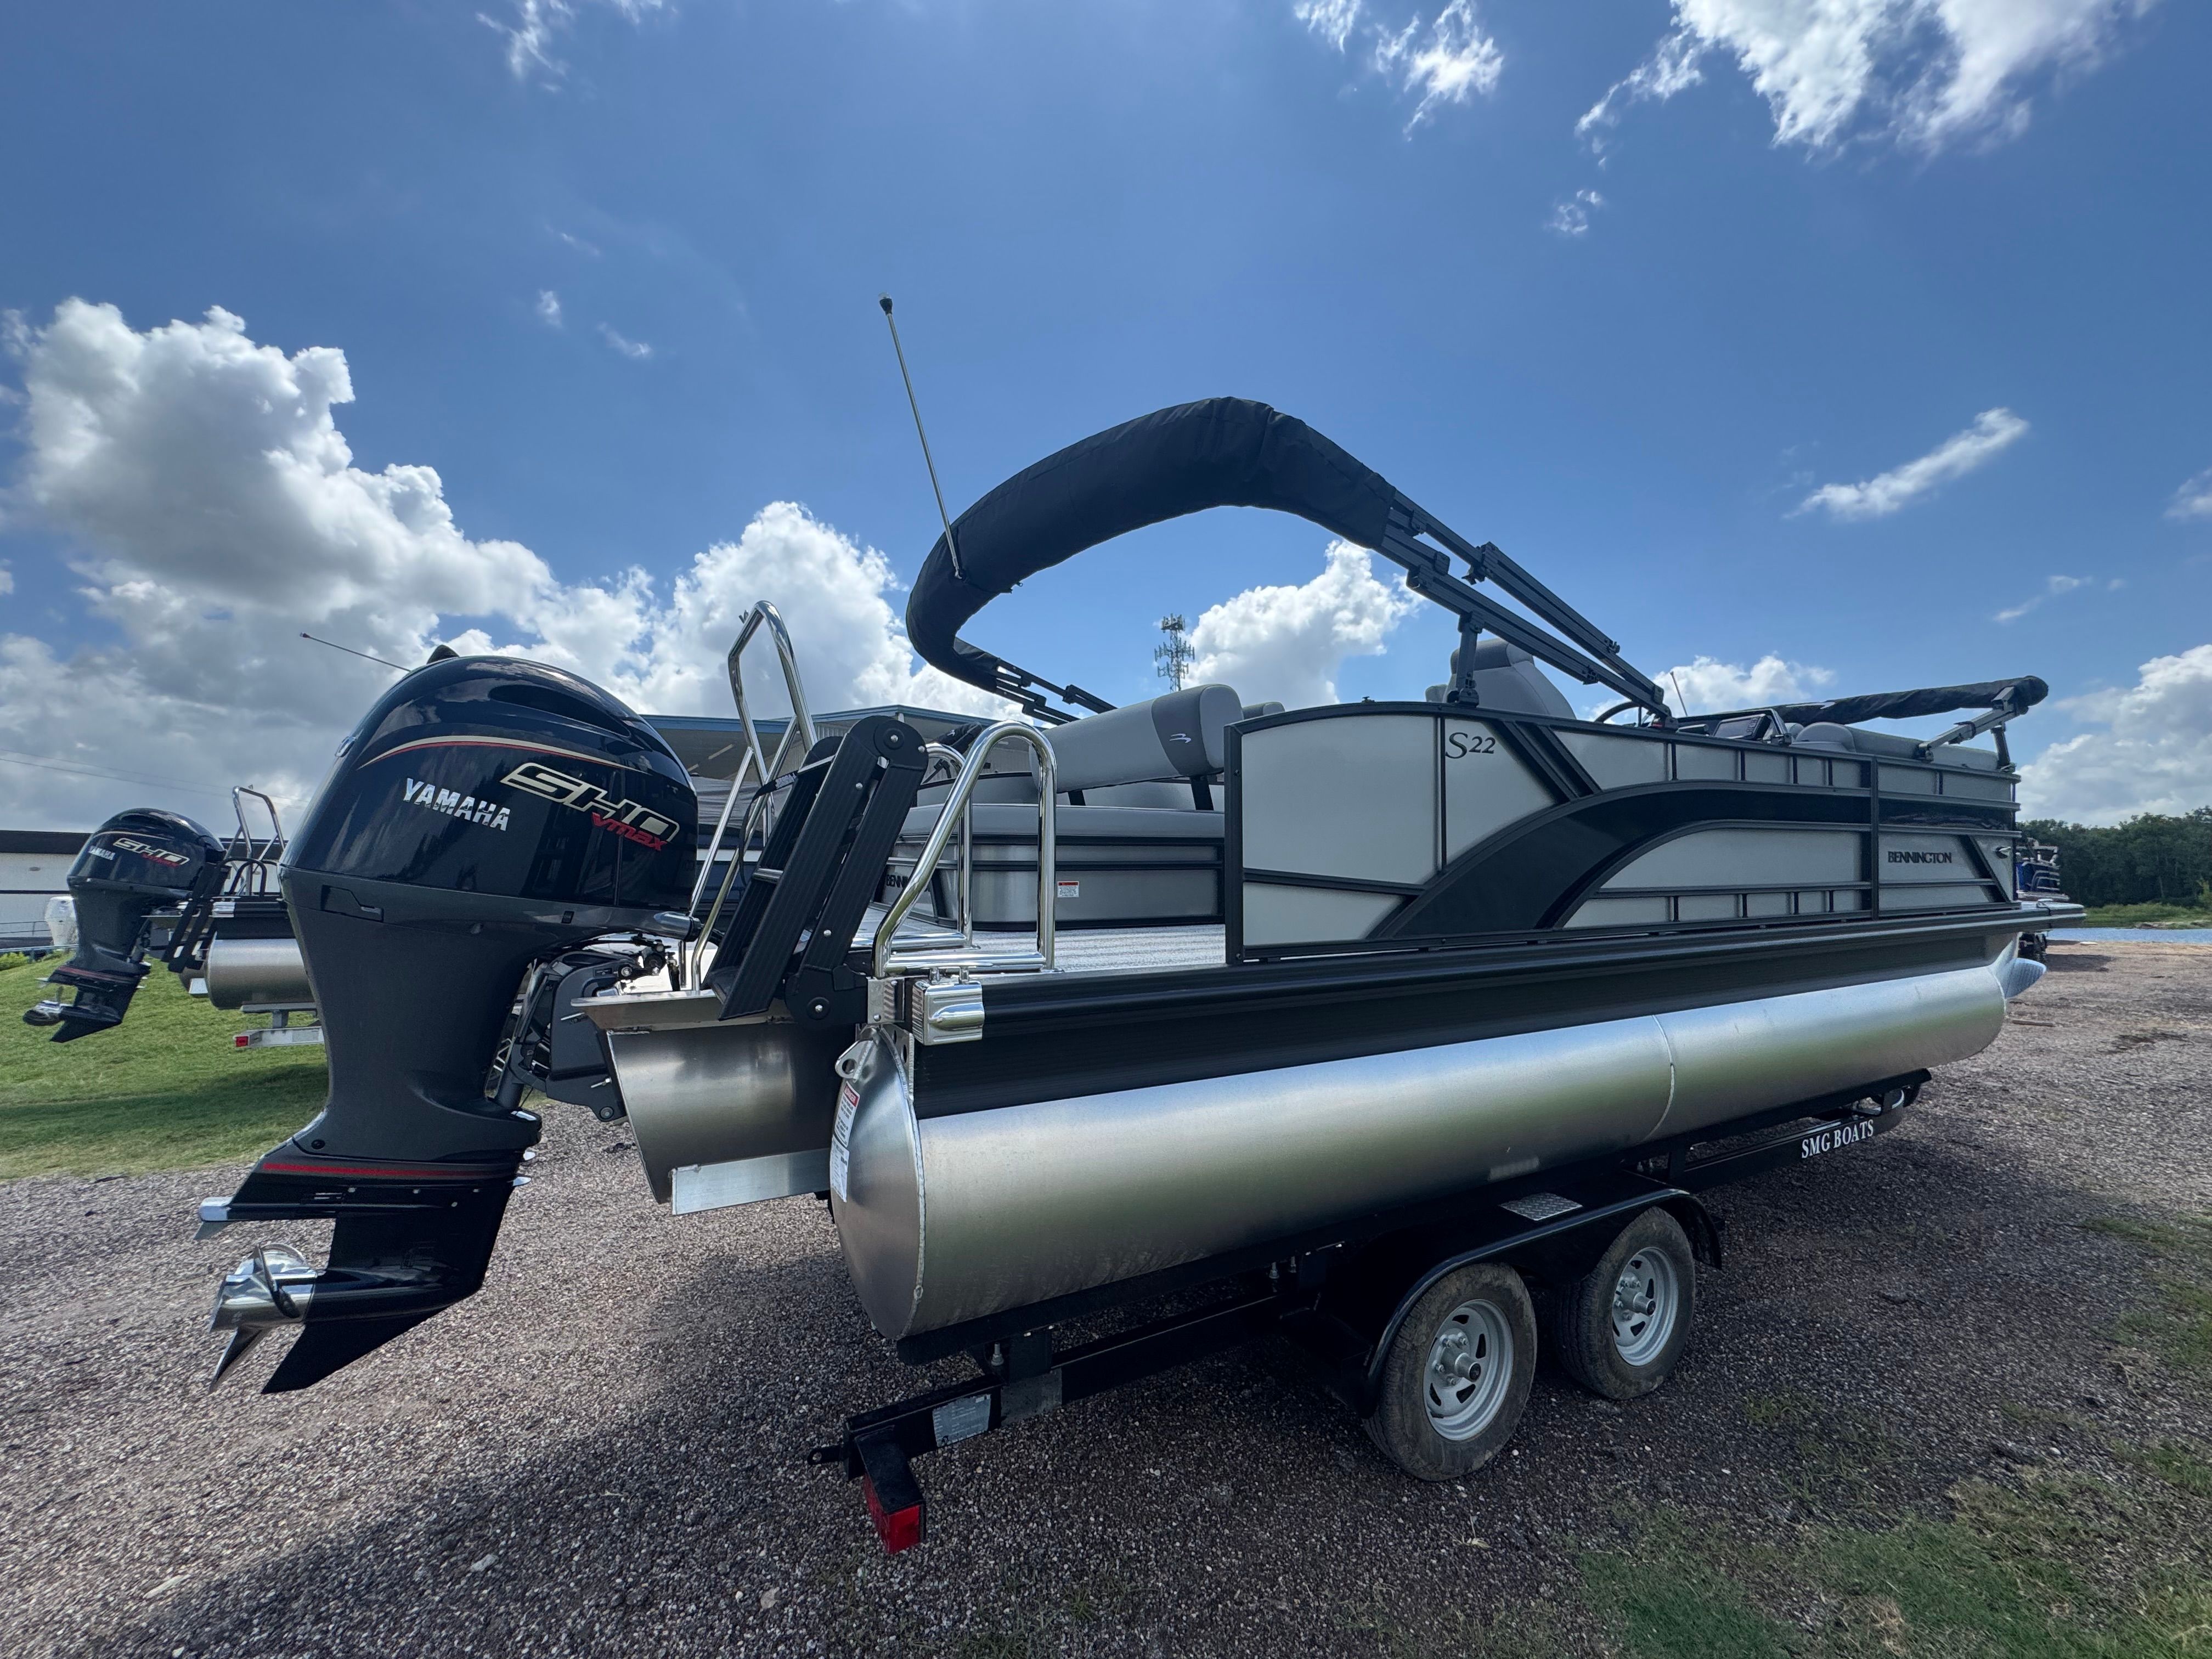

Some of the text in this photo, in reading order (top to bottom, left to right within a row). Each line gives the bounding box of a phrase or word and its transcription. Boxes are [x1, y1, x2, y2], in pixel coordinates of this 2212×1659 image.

[1445, 732, 1496, 759] S22
[403, 778, 511, 831] YAMAHA
[500, 762, 680, 842] SHO
[88, 845, 116, 861] YAMAHA
[113, 838, 190, 865] SHO
[1888, 851, 1952, 864] BENNINGTON
[1802, 1119, 1874, 1159] SMG BOATS
